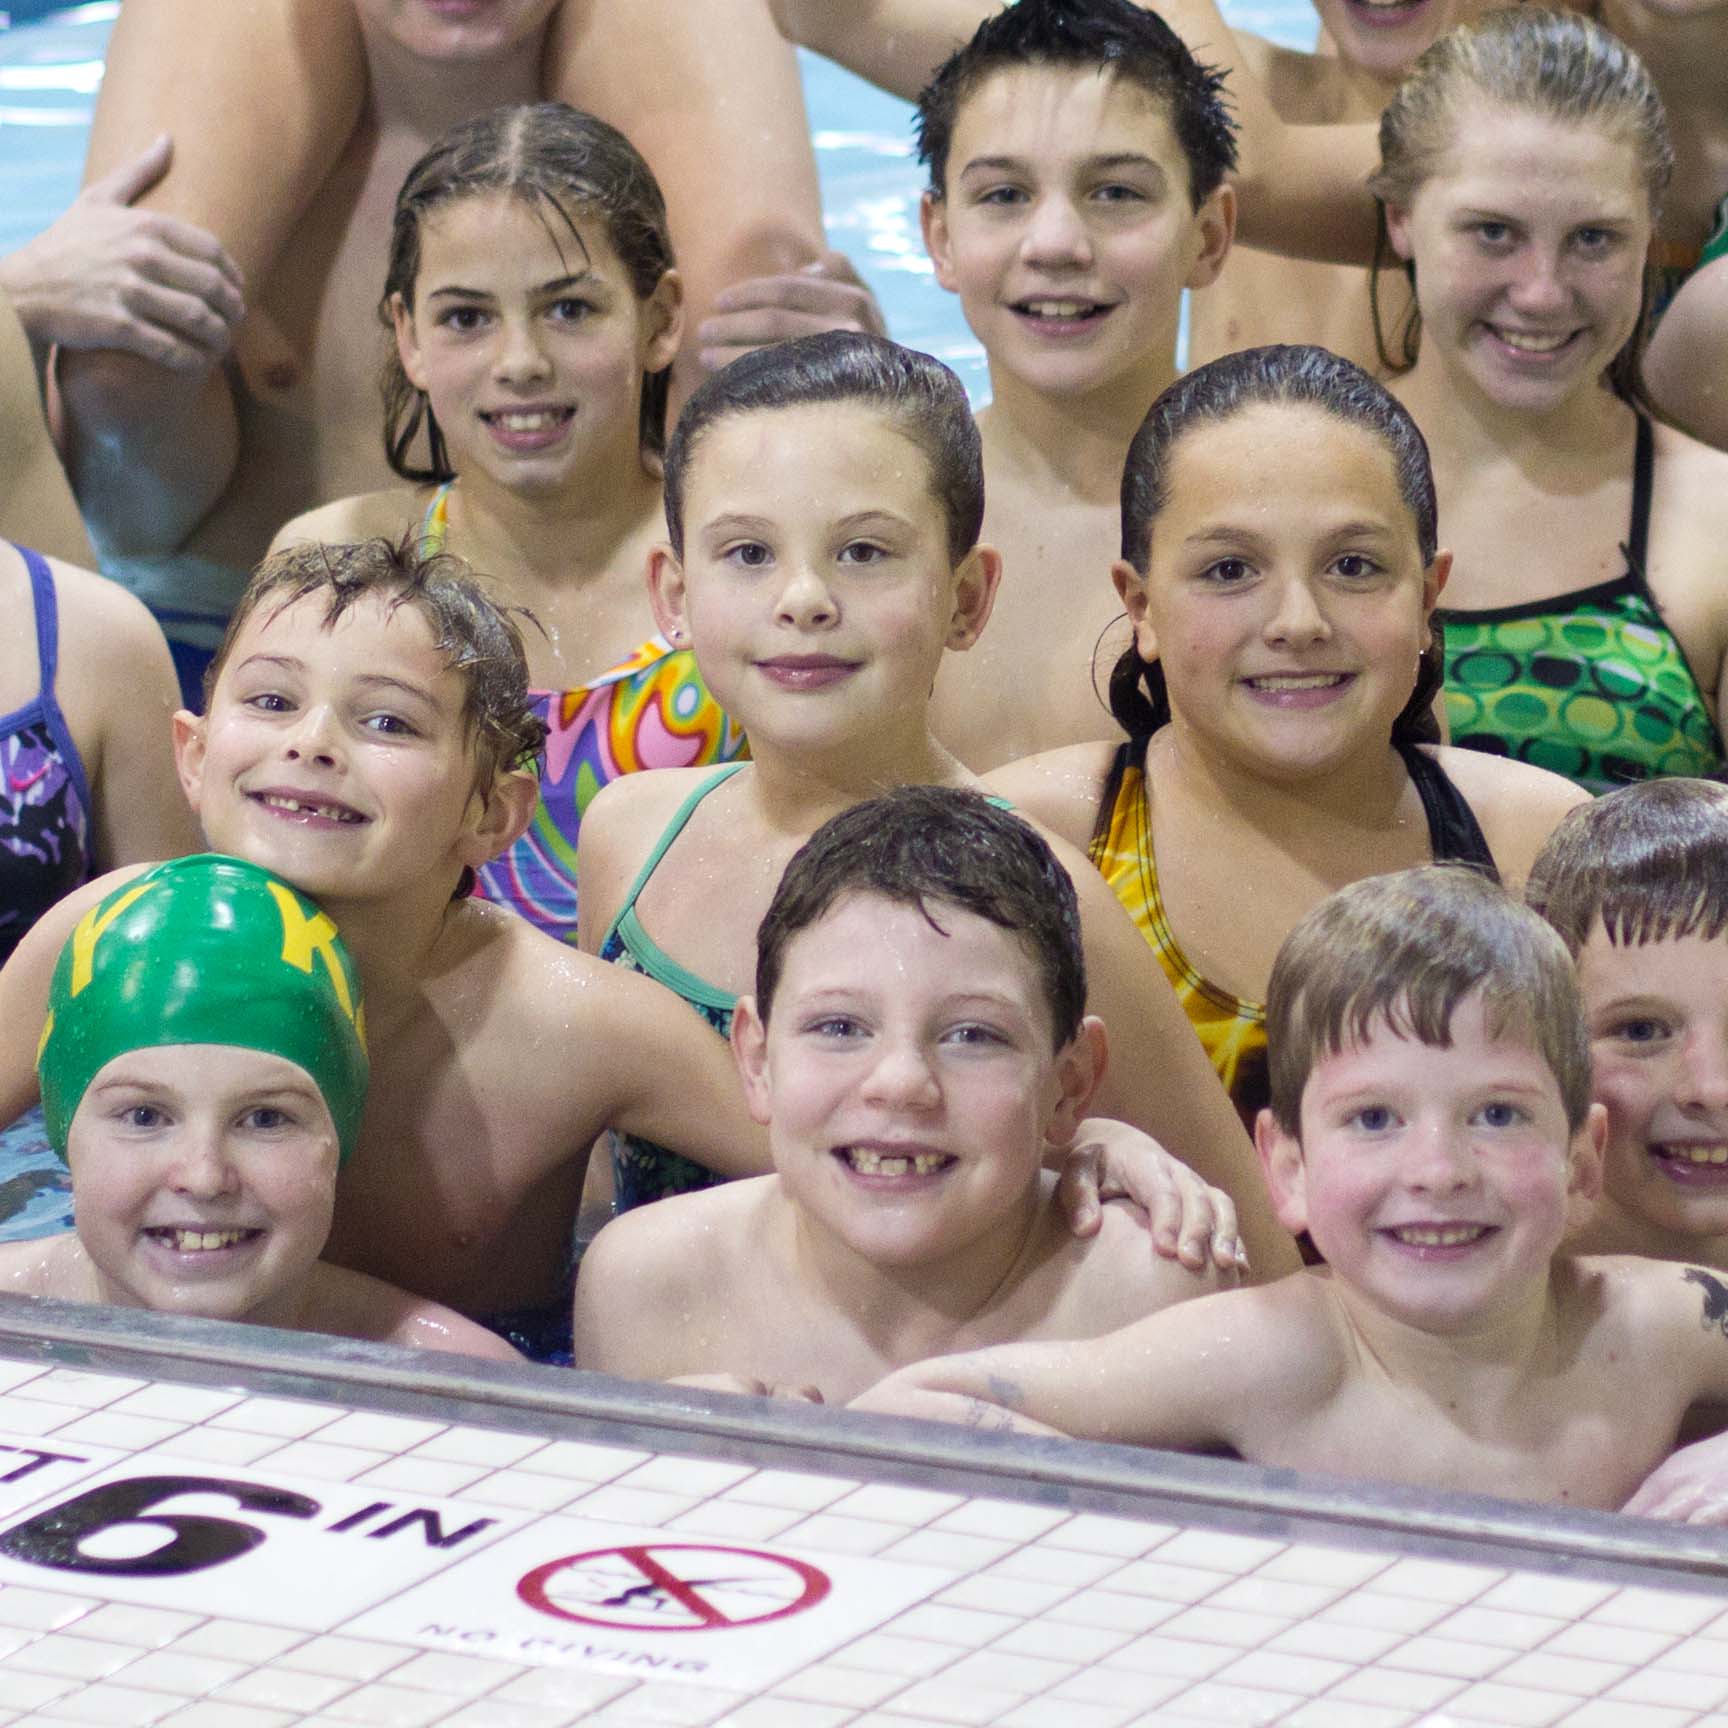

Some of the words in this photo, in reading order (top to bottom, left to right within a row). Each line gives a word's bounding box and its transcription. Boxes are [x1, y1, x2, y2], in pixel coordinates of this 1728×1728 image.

[324, 1501, 502, 1549] IN
[418, 1622, 497, 1642] NO
[518, 1634, 710, 1672] DIVING
